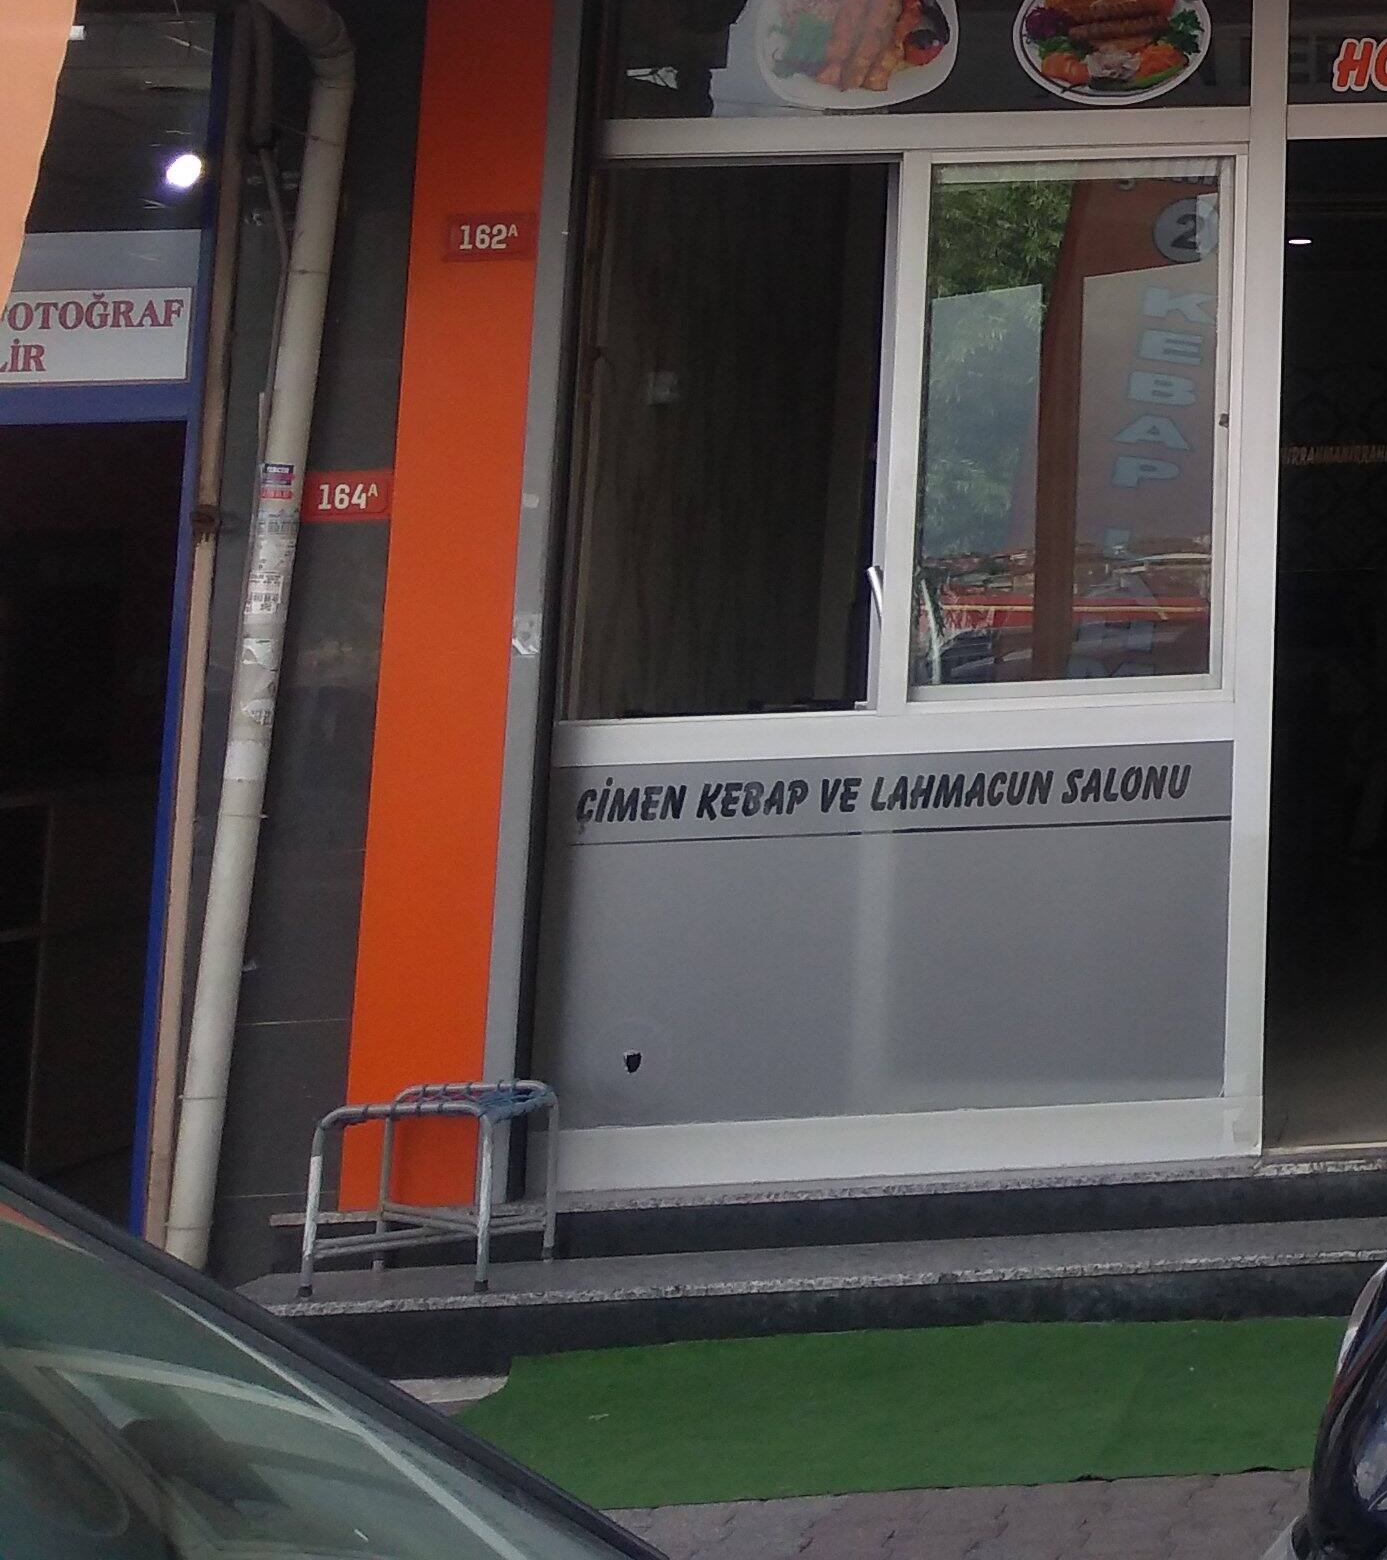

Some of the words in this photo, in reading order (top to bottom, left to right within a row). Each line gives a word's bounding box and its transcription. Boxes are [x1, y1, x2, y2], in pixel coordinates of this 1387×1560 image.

[0, 292, 185, 332] OTOĞRAF
[576, 776, 688, 833] ÇİMEN
[696, 779, 809, 821] KEBAP
[820, 776, 862, 814] VE
[870, 769, 1054, 813] LAHMACUN
[1060, 764, 1192, 805] SALONU
